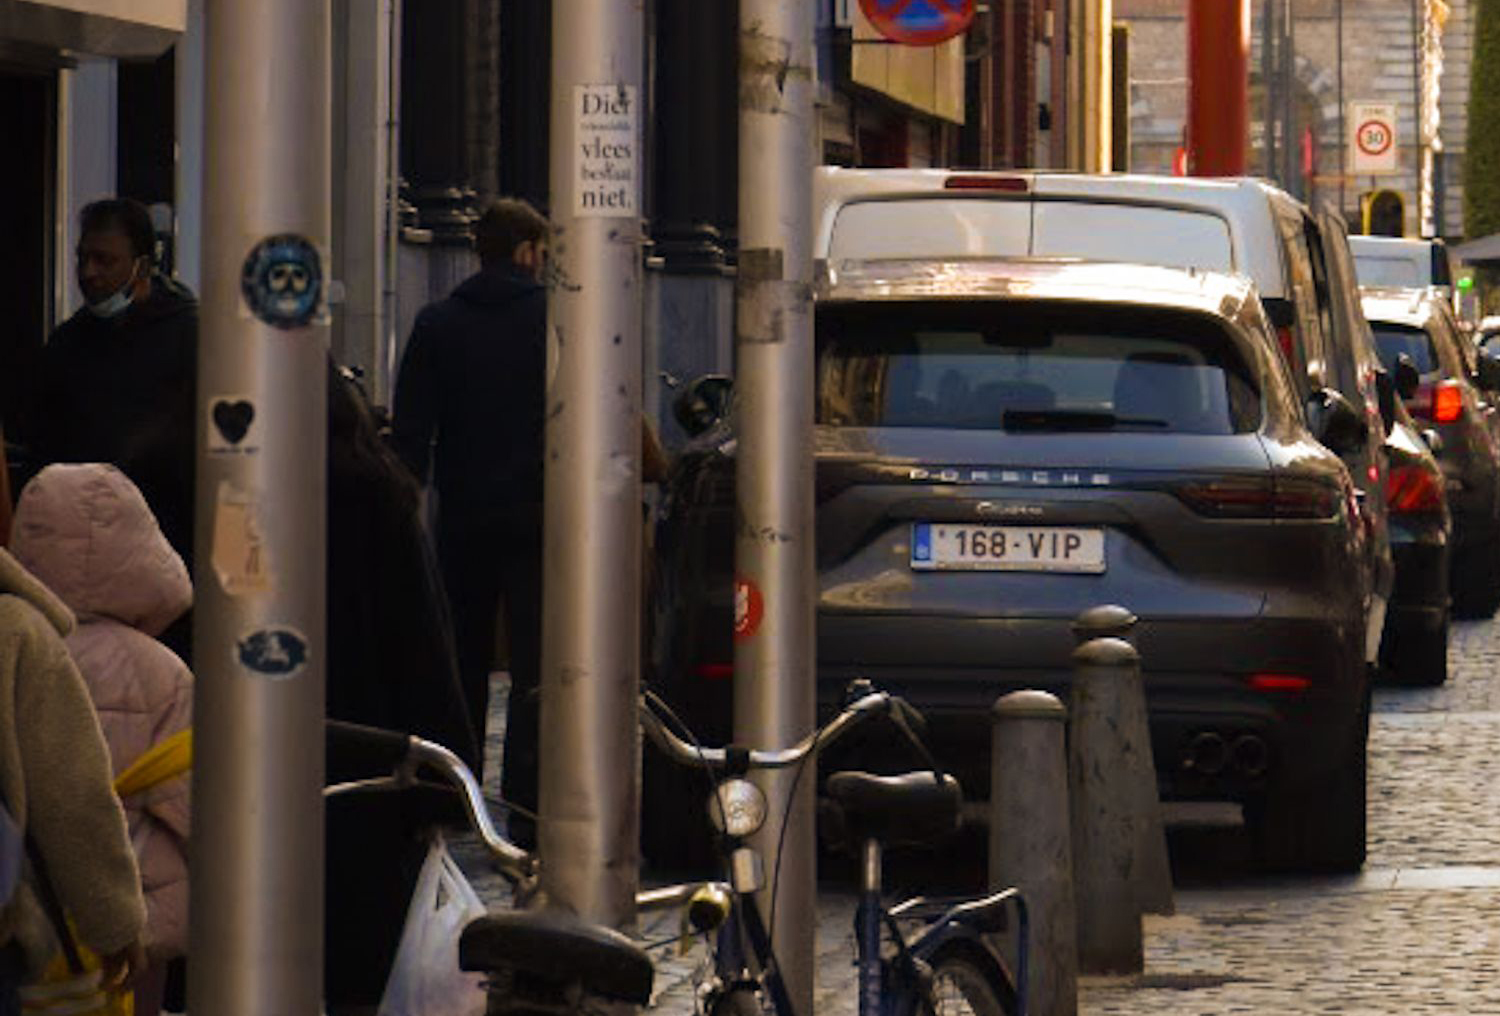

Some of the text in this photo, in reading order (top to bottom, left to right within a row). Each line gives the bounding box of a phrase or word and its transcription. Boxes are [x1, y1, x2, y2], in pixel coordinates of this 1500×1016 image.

[582, 92, 632, 115] Dier
[581, 136, 632, 158] vlees
[1365, 129, 1384, 145] 30
[582, 185, 632, 209] niet.
[909, 469, 1110, 485] PORSCHE
[955, 530, 1081, 559] 168-VIP
